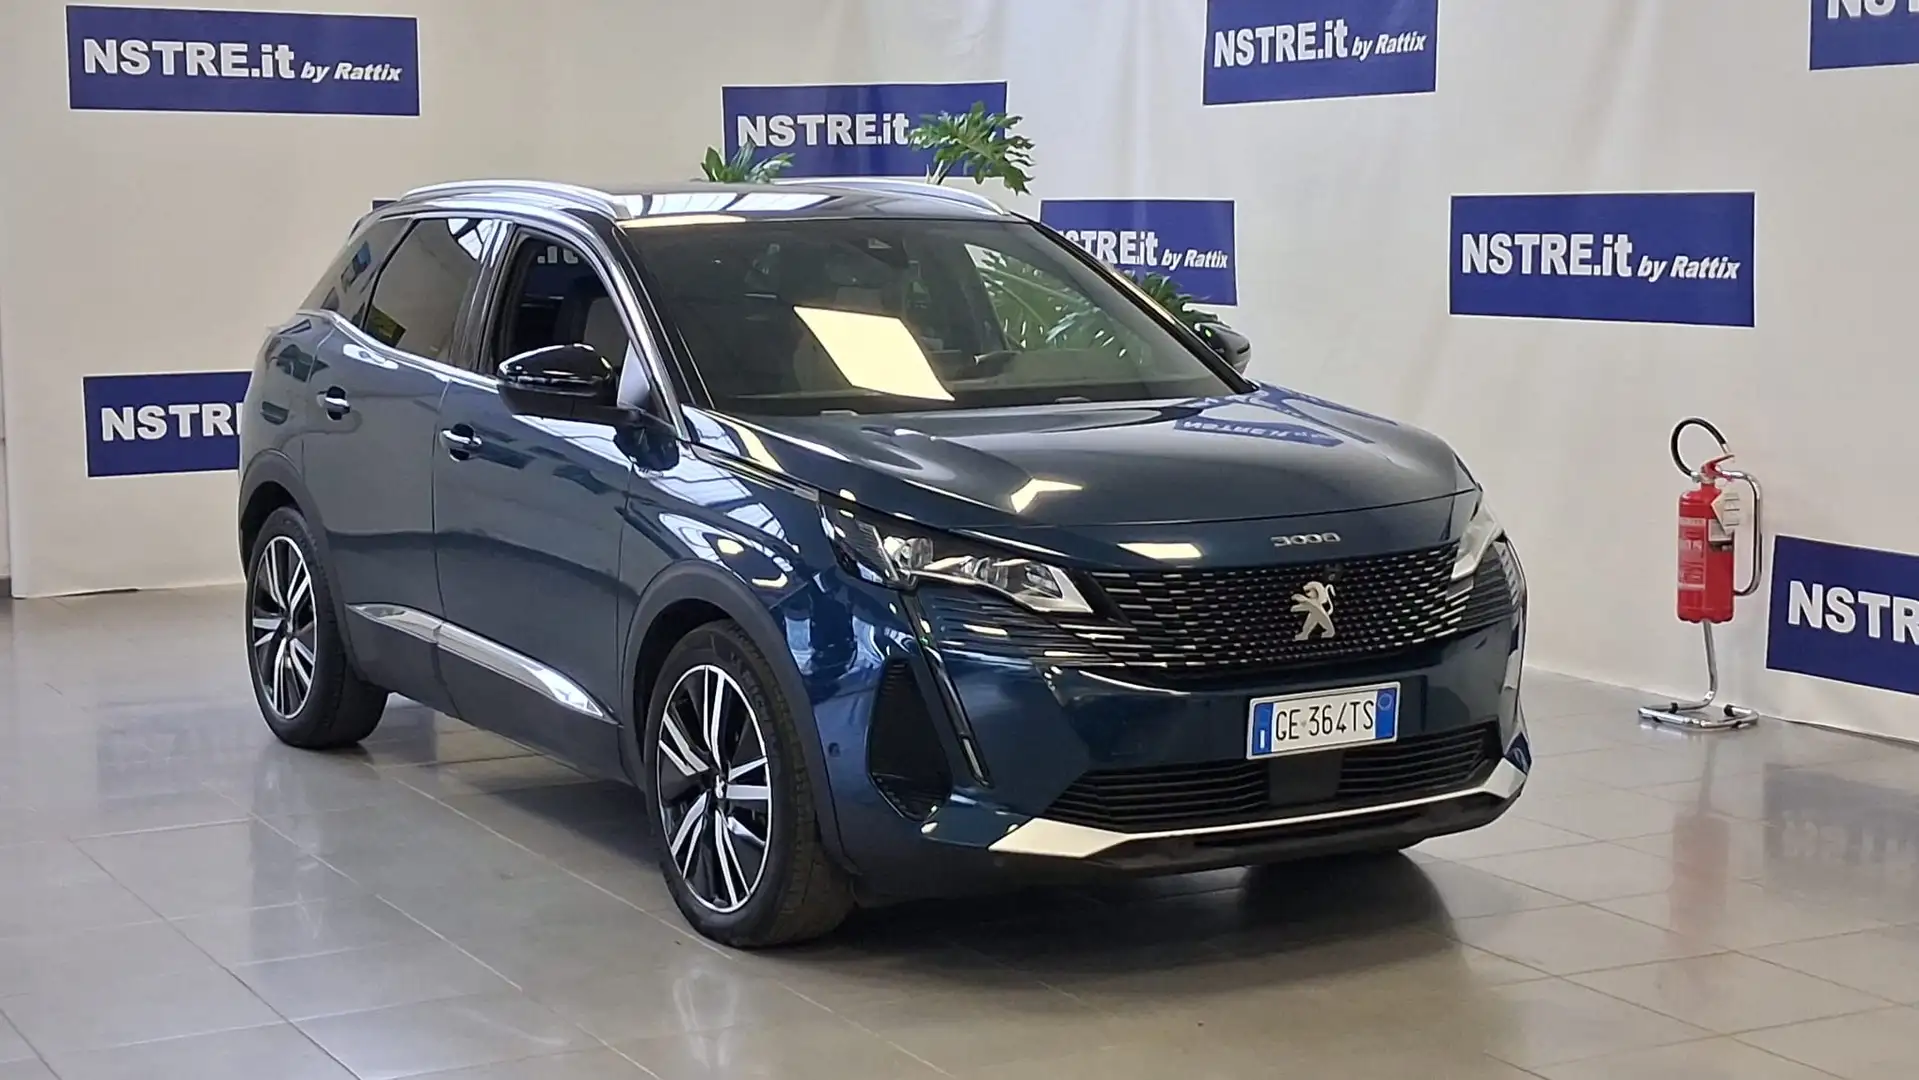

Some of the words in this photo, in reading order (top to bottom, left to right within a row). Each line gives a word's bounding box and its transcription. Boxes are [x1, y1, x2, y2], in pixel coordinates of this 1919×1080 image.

[83, 38, 295, 79] NSTRE.it
[300, 61, 329, 84] by
[333, 61, 403, 82] Rattix
[1213, 18, 1348, 68] NSTRE.it
[1351, 36, 1373, 62] by
[1374, 31, 1427, 55] Rattix
[737, 112, 909, 147] NSTRE.it
[1056, 230, 1158, 266] TRE.it
[1161, 248, 1183, 271] by
[1184, 249, 1229, 269] Rattix
[1461, 233, 1633, 278] NSTRE.it
[1637, 255, 1667, 282] by
[1670, 255, 1741, 280] Rattix
[101, 402, 244, 441] NSTR
